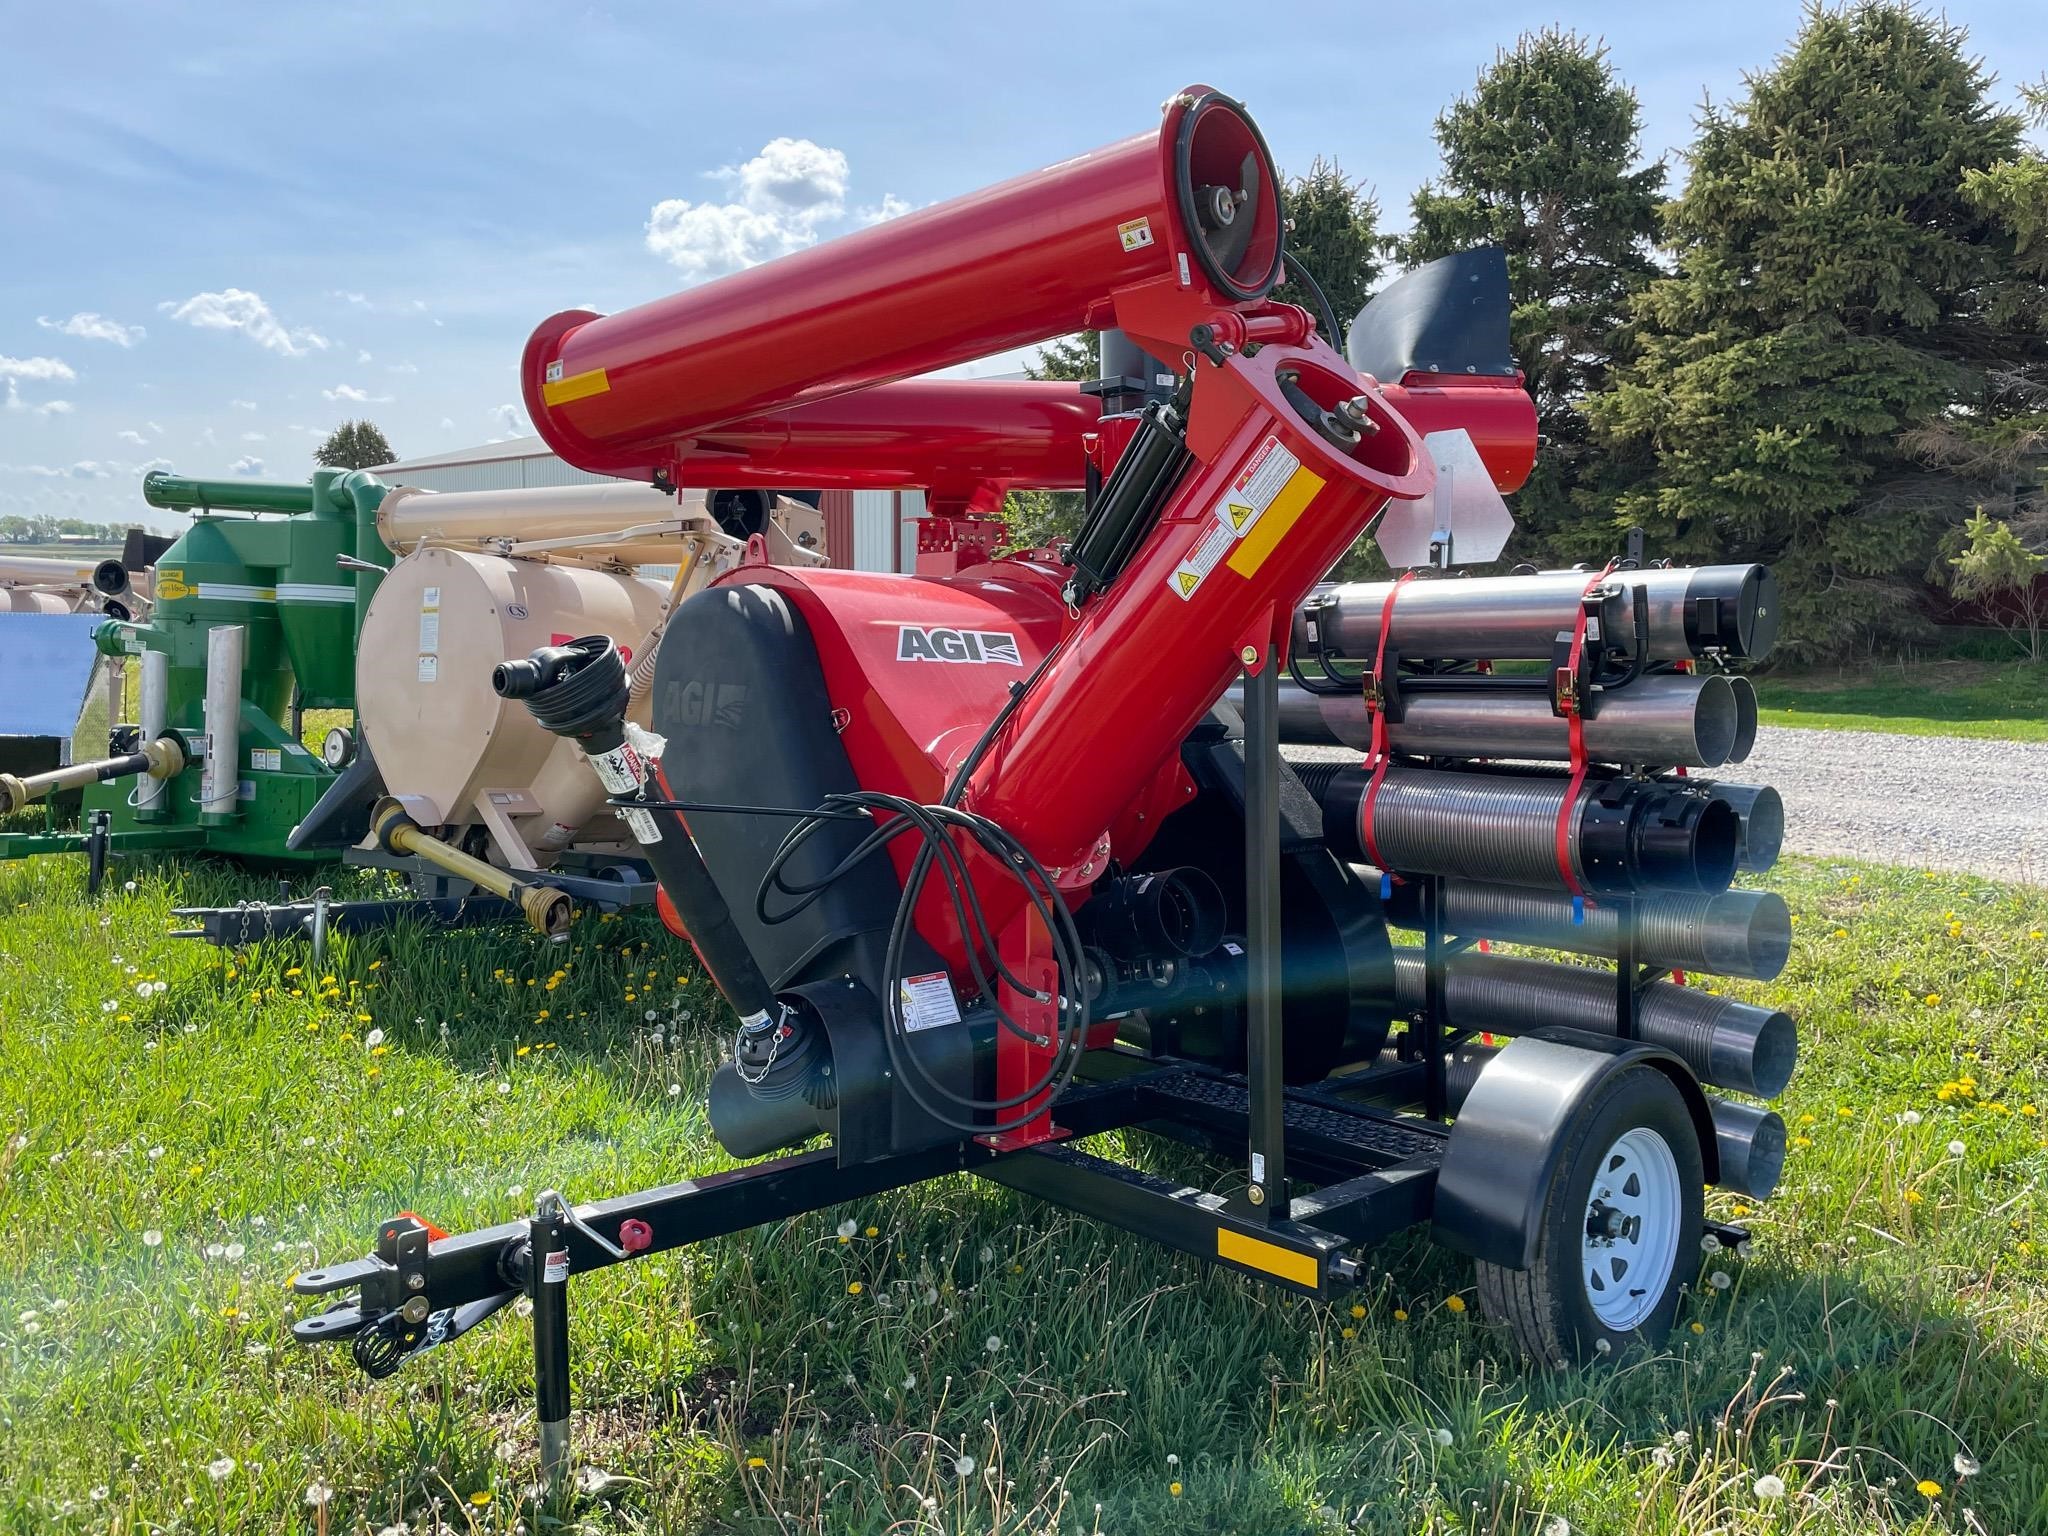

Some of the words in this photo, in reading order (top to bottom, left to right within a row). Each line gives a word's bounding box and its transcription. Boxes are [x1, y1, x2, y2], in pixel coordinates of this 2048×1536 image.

[1248, 444, 1272, 473] DANGER
[1197, 529, 1213, 549] DANGER
[510, 605, 526, 617] CS
[901, 628, 983, 661] AGI
[662, 680, 715, 727] AGI
